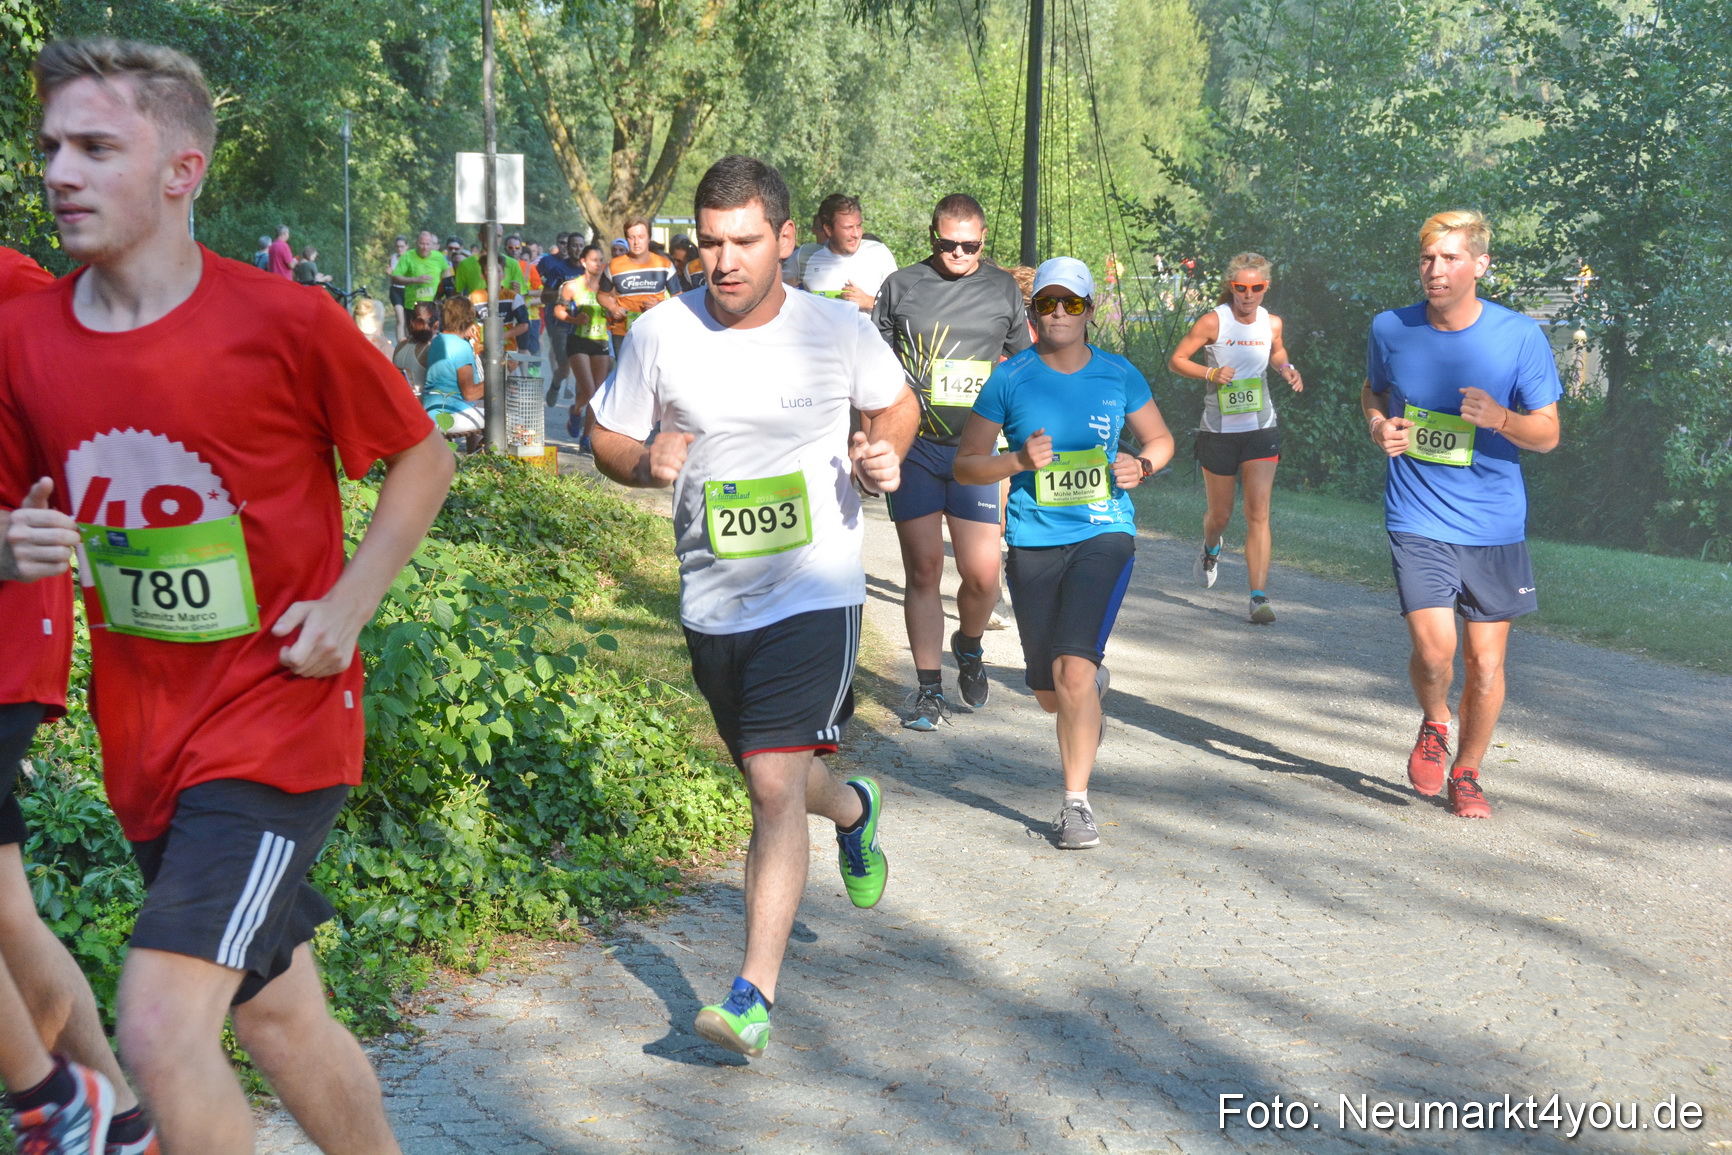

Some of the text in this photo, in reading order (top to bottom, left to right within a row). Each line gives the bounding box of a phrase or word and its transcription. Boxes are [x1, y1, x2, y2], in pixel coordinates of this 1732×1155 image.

[628, 279, 658, 288] Fischer
[940, 375, 983, 394] 1425
[780, 396, 813, 408] Luca
[1102, 399, 1117, 407] Melli
[1228, 390, 1254, 405] 896
[1415, 427, 1457, 451] 660
[1045, 467, 1101, 491] 1400
[719, 502, 798, 536] 2093
[119, 567, 211, 610] 780
[132, 607, 217, 623] Schmitz Marco
